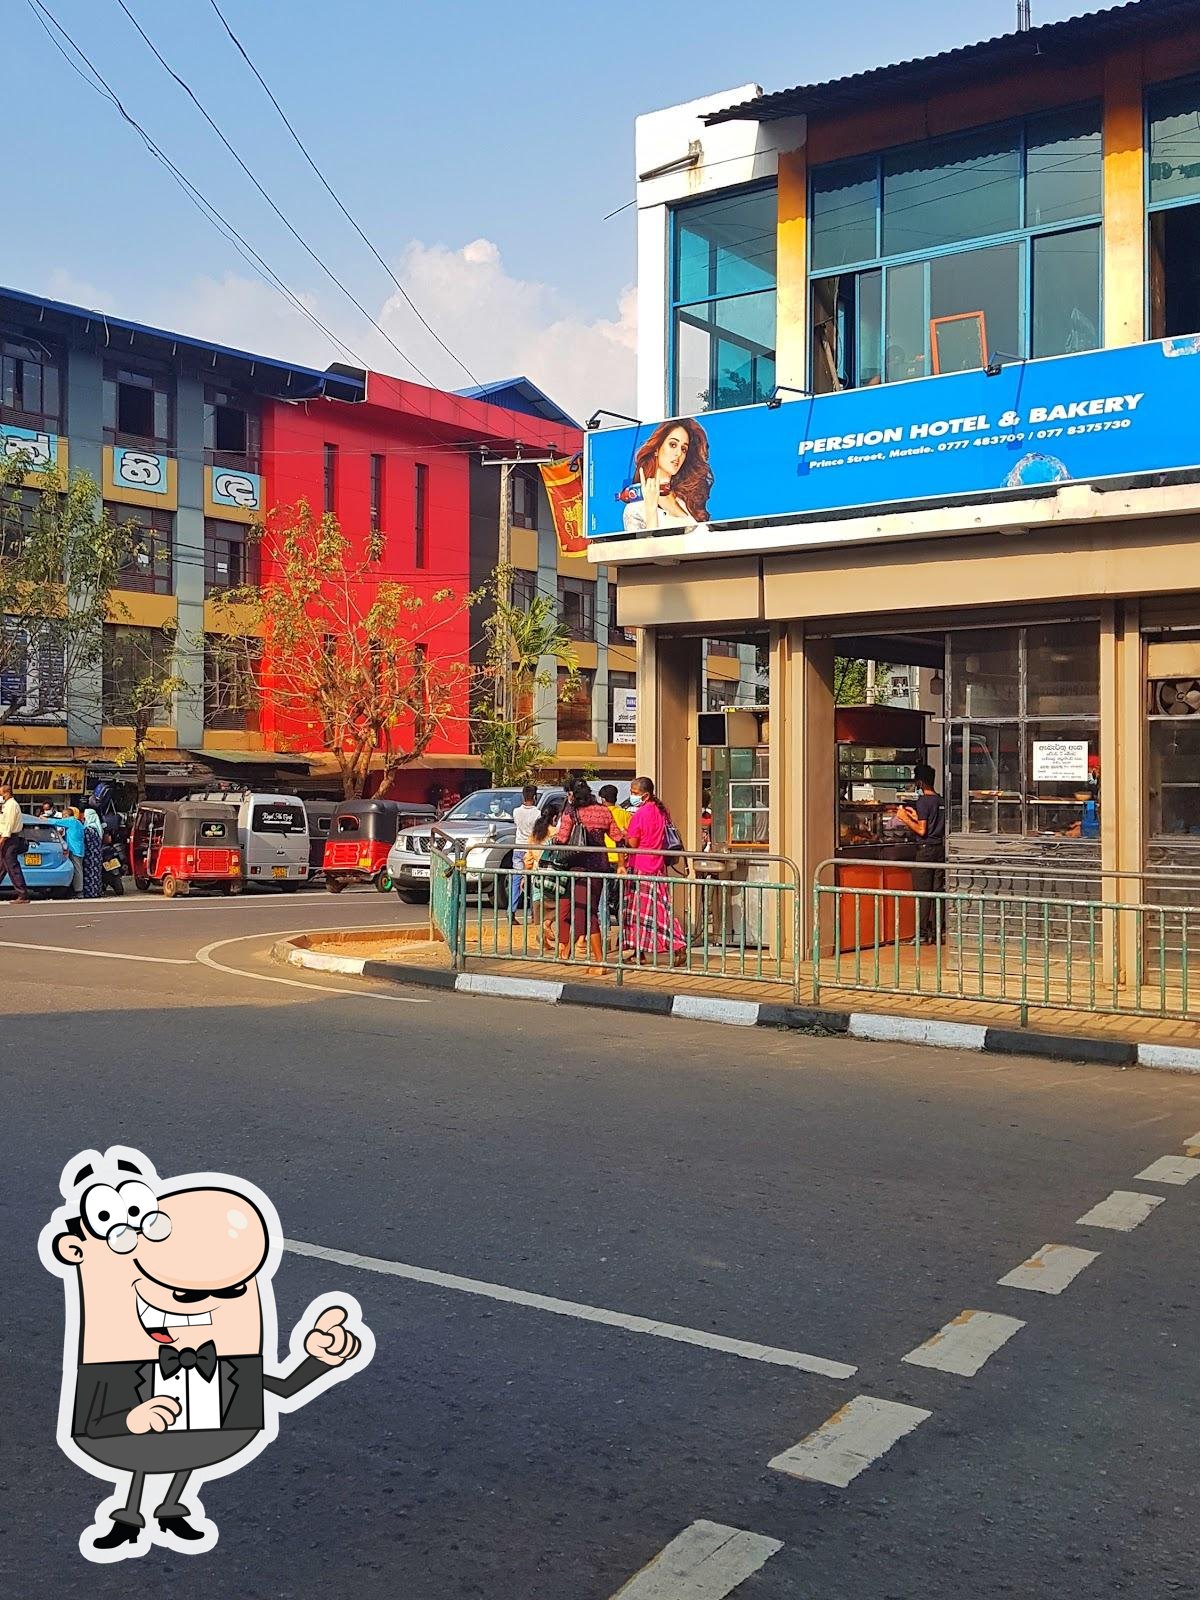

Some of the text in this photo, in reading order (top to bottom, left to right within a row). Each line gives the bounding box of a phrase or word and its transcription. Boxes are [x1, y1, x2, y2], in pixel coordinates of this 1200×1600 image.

[798, 393, 1144, 455] PERSION HOTEL & BAKERY
[809, 457, 844, 469] Prince
[847, 451, 885, 464] Street,
[937, 439, 970, 452] 0777
[973, 432, 1025, 447] 483709
[1036, 427, 1064, 439] 077
[1067, 418, 1132, 435] 8375730
